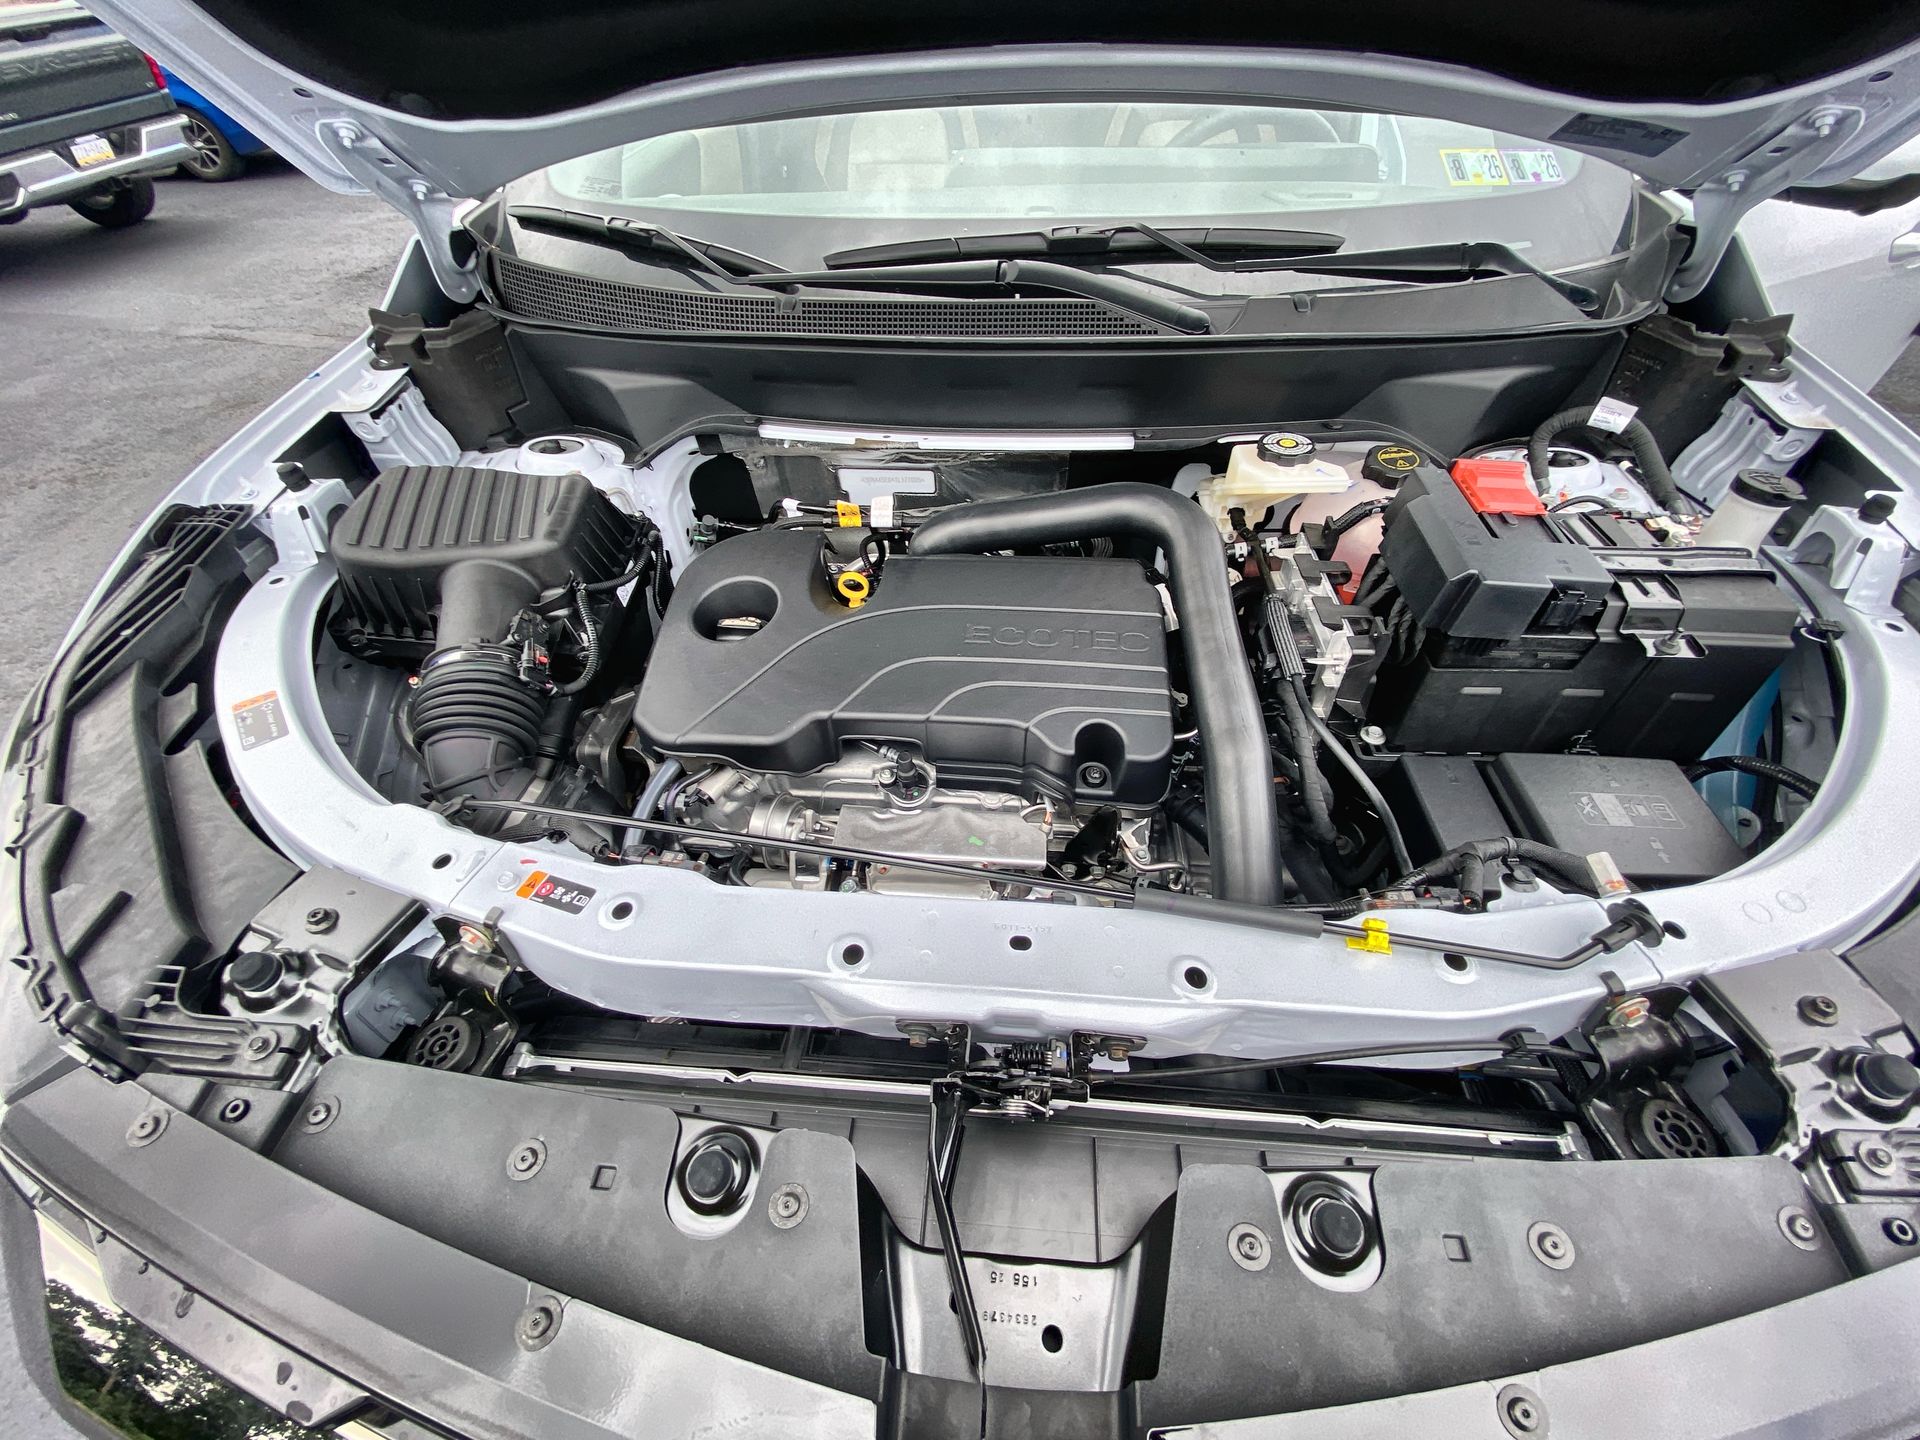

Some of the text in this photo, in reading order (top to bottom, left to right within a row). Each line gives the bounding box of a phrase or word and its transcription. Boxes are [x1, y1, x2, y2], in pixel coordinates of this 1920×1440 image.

[1483, 154, 1503, 179] 26
[1541, 154, 1560, 178] 26
[964, 623, 1150, 652] ECOTEC
